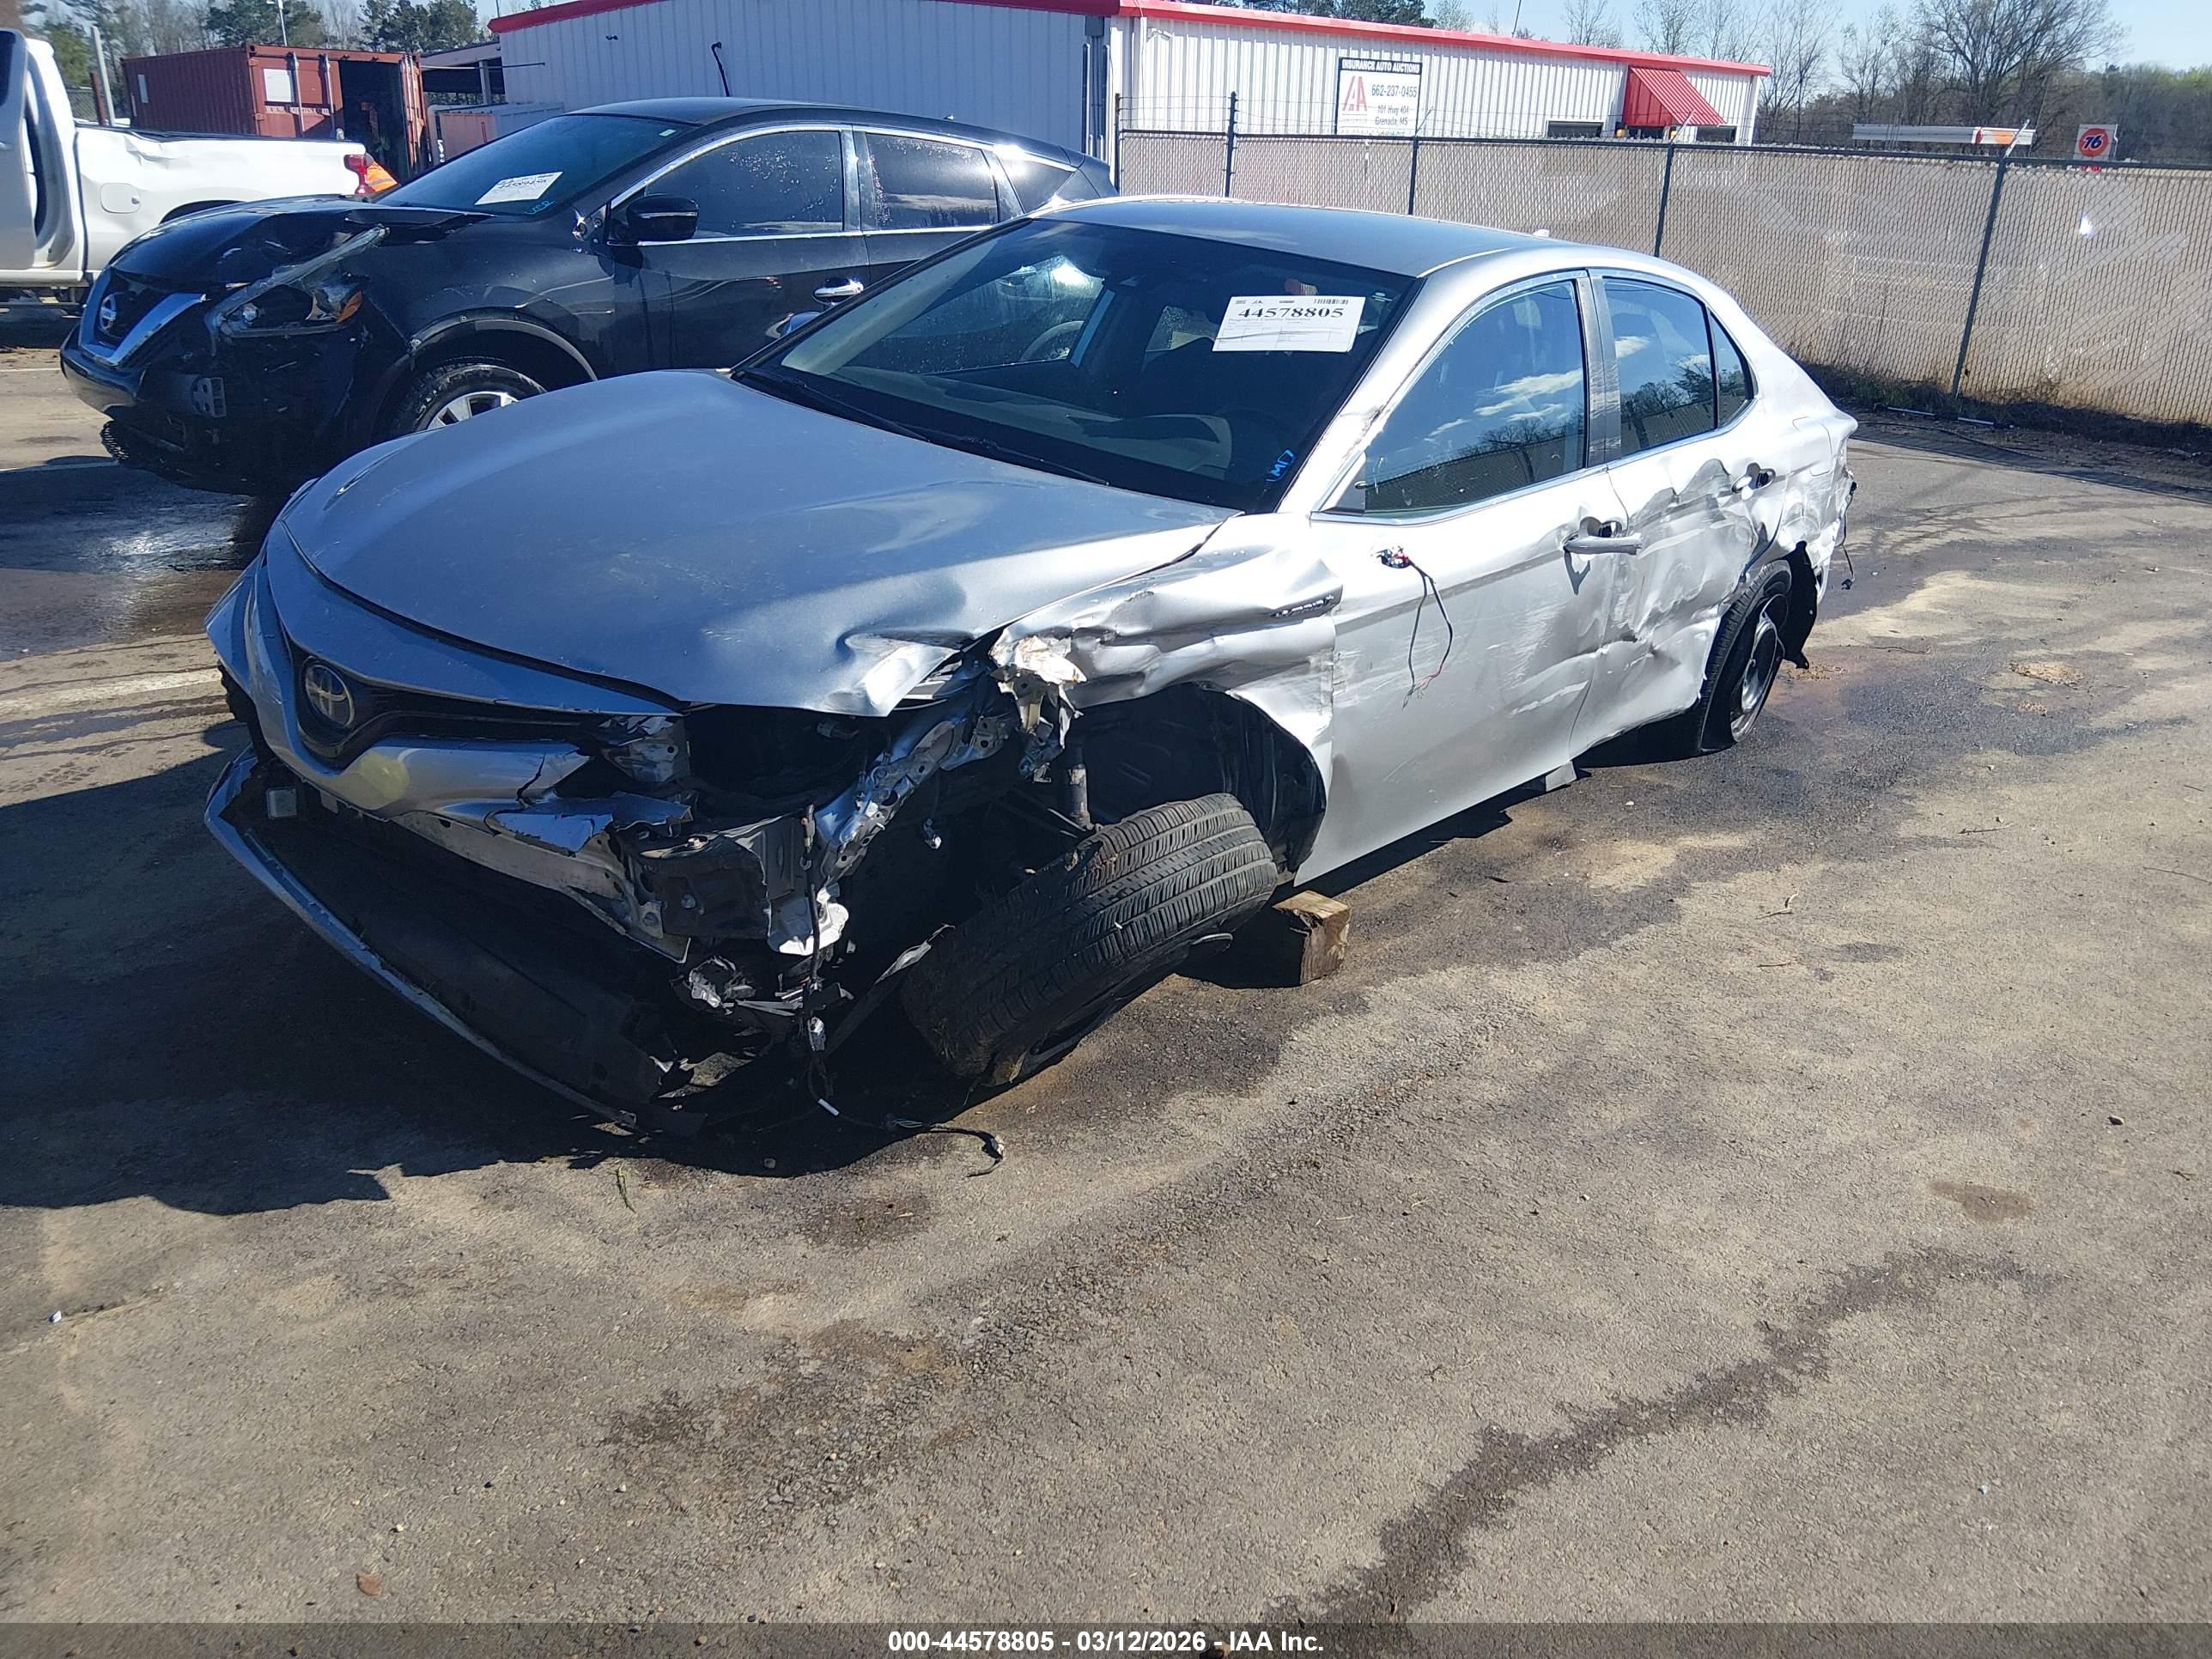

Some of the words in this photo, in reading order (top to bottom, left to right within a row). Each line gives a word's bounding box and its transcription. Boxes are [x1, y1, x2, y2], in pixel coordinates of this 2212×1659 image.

[1341, 59, 1376, 70] INSURANCE
[1376, 61, 1392, 71] AUTO
[1392, 63, 1419, 73] AUCTIONS
[1388, 105, 1399, 115] Hwy
[1400, 117, 1408, 125] MS
[2083, 135, 2103, 149] 76
[1237, 307, 1344, 318] 44578805
